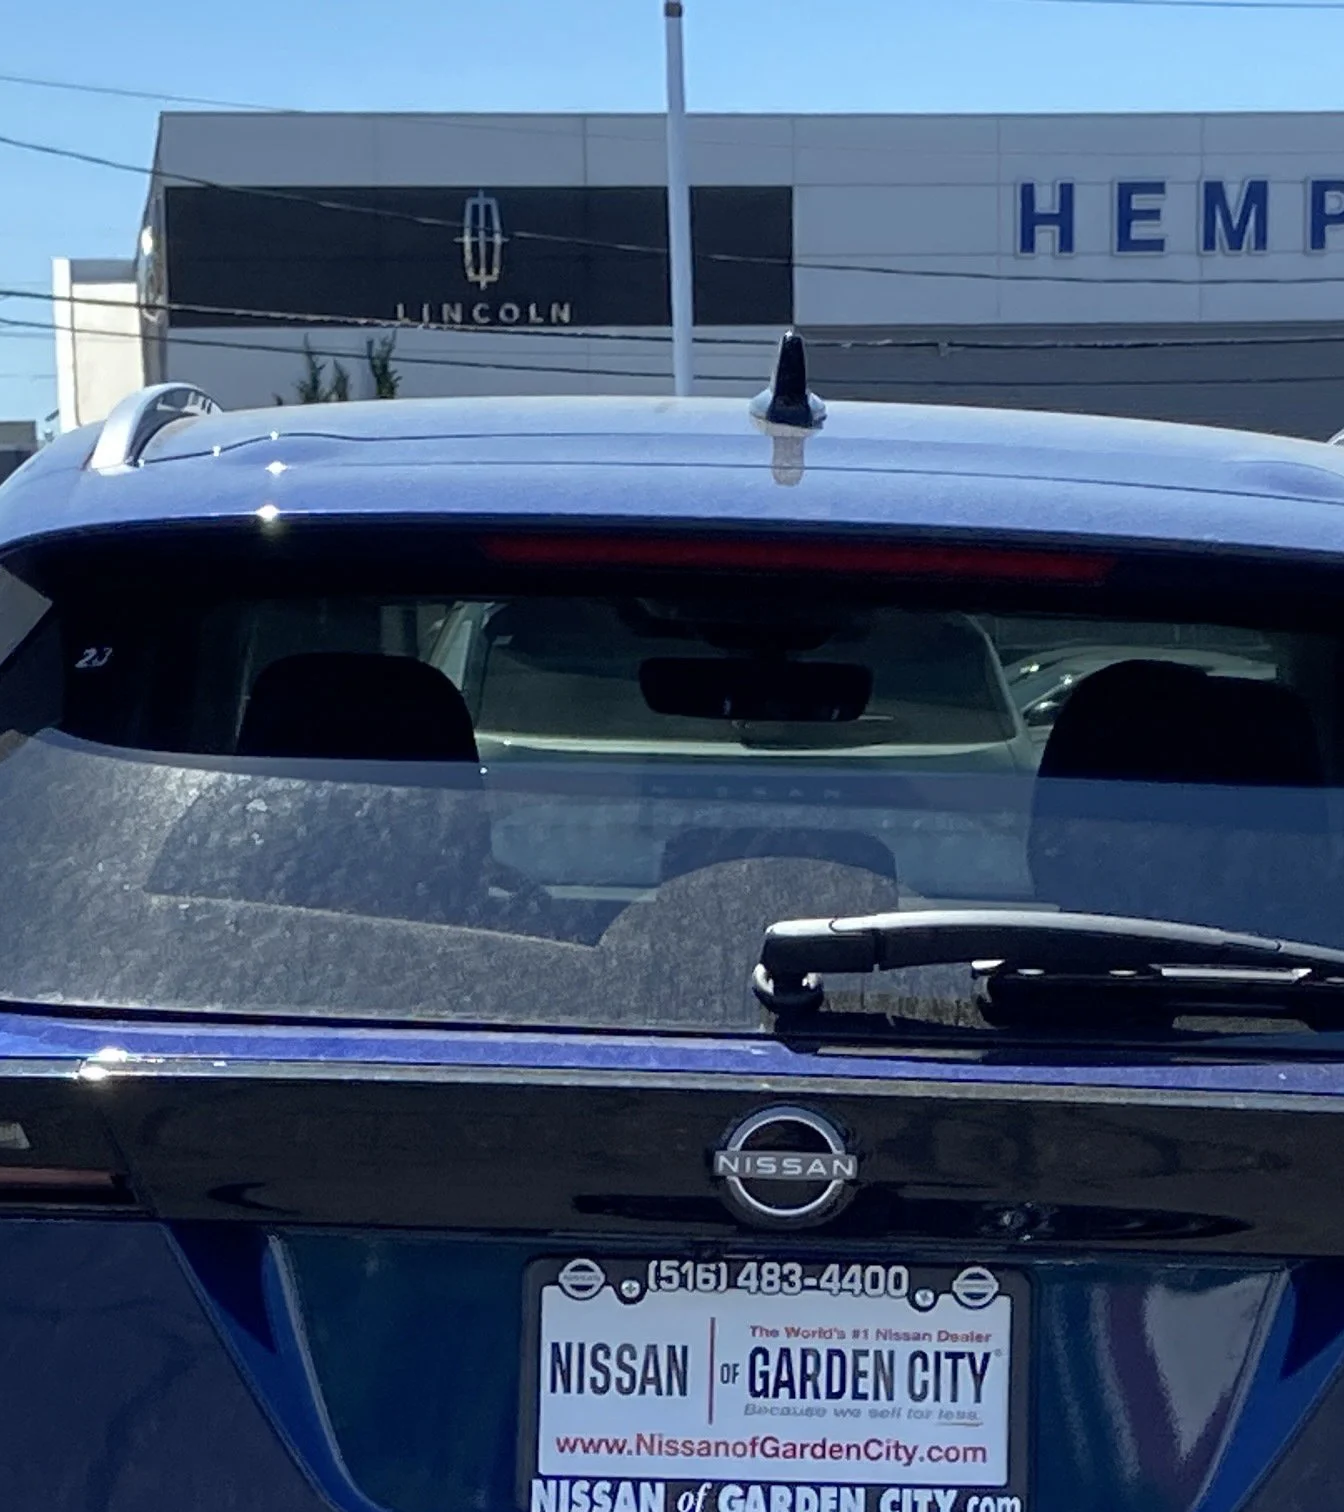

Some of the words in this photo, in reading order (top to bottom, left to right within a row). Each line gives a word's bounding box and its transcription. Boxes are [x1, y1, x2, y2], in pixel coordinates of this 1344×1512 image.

[396, 302, 572, 325] LINCOLN
[717, 1154, 854, 1177] NISSAN
[647, 1259, 729, 1293] (516)
[735, 1261, 910, 1298] 483-4400
[749, 1324, 779, 1338] The
[784, 1326, 846, 1340] World's
[852, 1328, 870, 1341] #1
[875, 1329, 932, 1343] Nissan
[936, 1329, 993, 1344] Dealer
[549, 1342, 689, 1397] NISSAN
[719, 1363, 741, 1385] OF
[747, 1346, 895, 1402] GARDEN
[907, 1350, 992, 1405] CITY
[744, 1403, 827, 1418] Because
[833, 1407, 862, 1419] we
[907, 1407, 932, 1420] for
[555, 1432, 987, 1467] www.NissanofGardenCity.com
